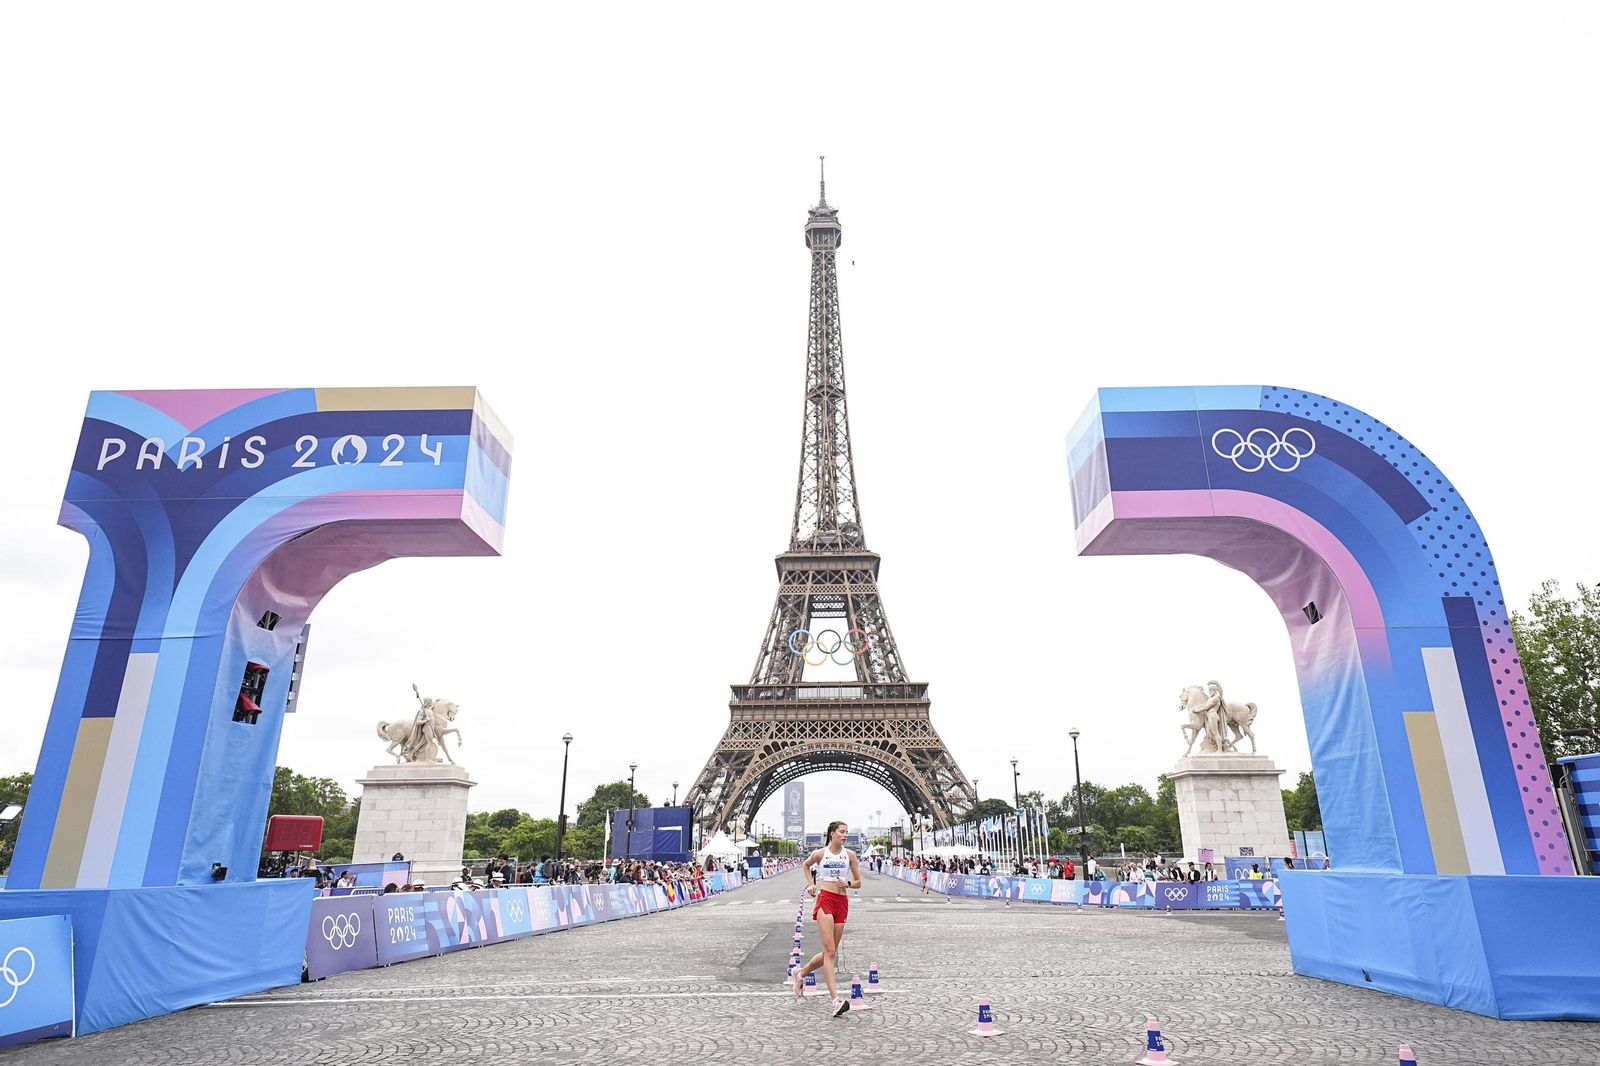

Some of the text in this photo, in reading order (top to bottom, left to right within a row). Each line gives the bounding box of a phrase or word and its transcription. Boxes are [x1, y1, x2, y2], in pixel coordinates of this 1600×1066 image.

[291, 433, 443, 469] 2024
[1206, 893, 1230, 902] 2024
[390, 925, 417, 944] 2024
